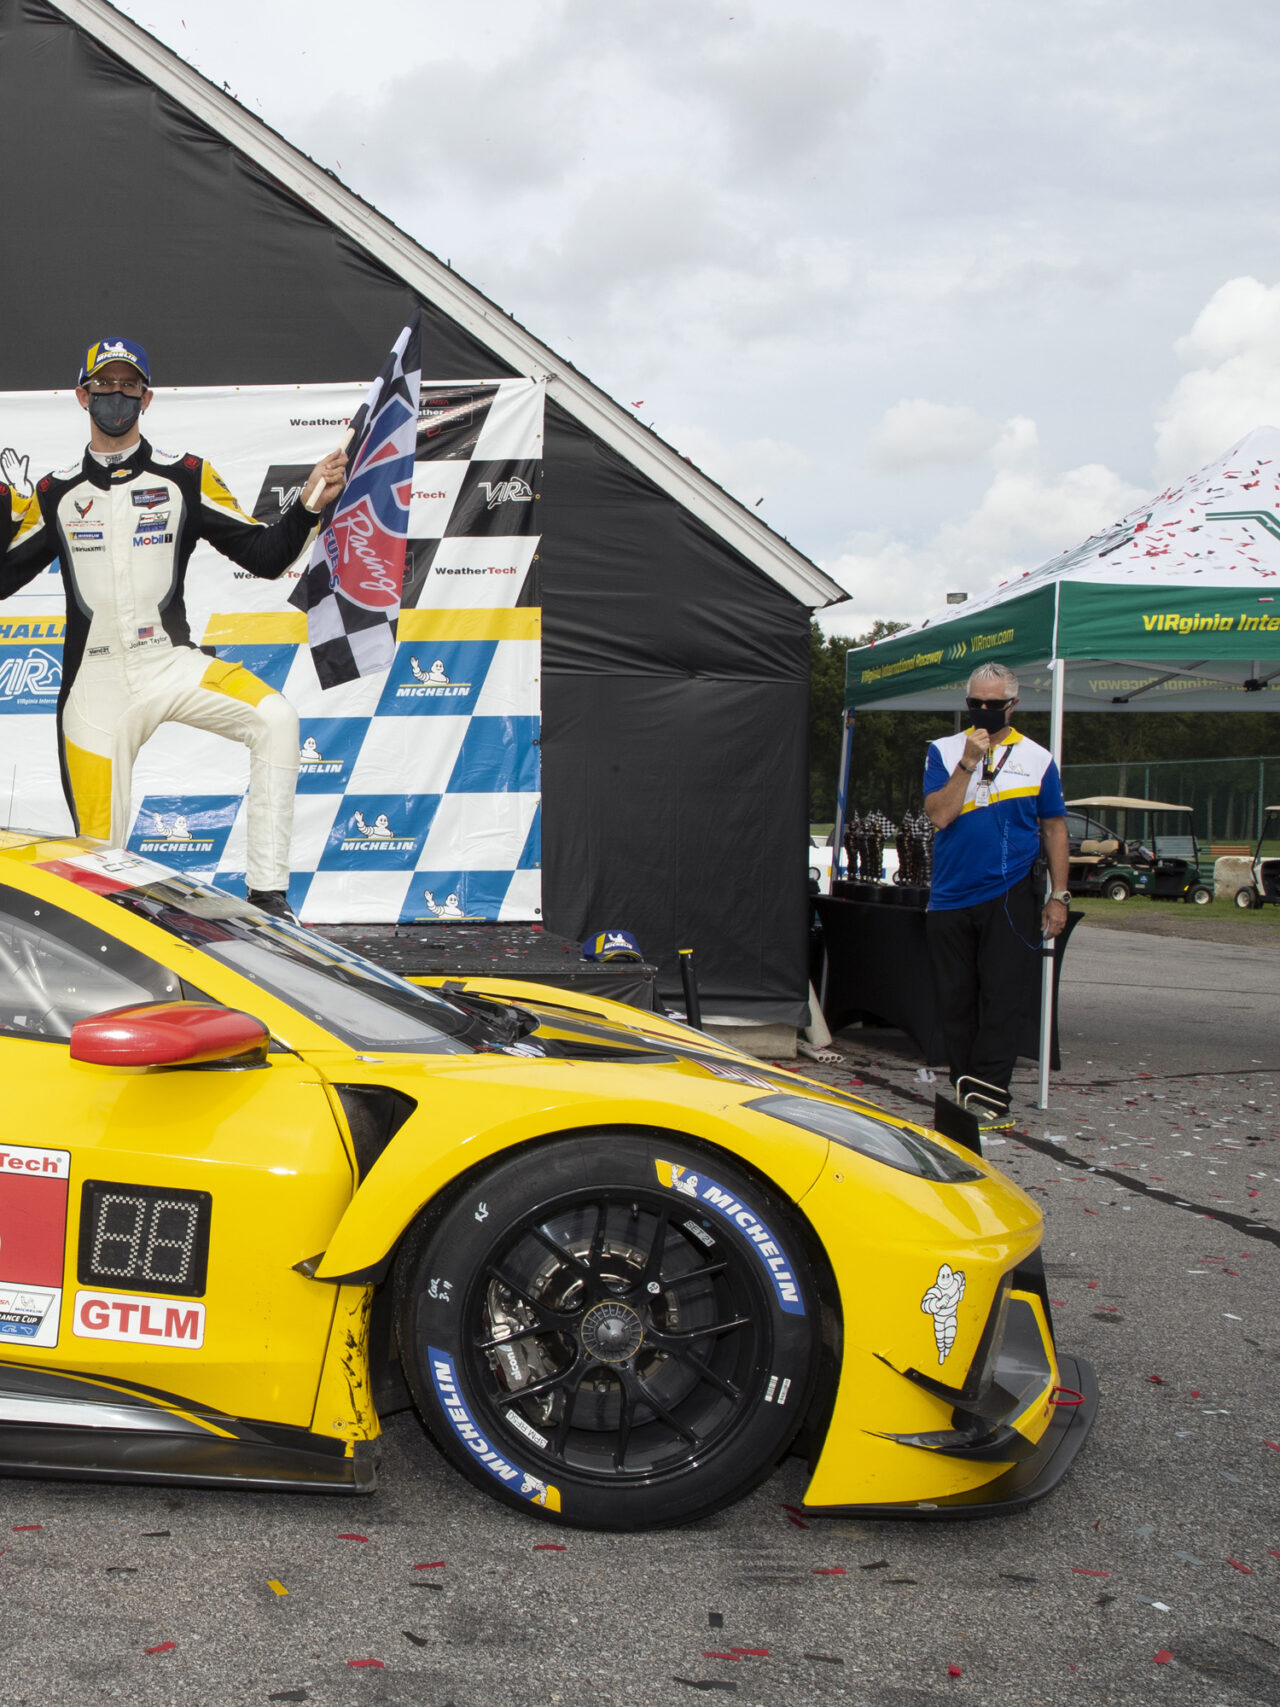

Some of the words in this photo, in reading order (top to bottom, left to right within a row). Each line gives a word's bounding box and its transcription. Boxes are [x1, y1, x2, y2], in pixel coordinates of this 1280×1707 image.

[478, 478, 532, 508] VIR
[436, 567, 516, 575] WeatherTech
[1142, 613, 1234, 634] VIRginia
[971, 629, 1015, 652] VIRnow.com
[396, 688, 470, 697] MICHELIN
[140, 842, 212, 851] MICHELIN
[341, 841, 414, 850] MICHELIN
[703, 1186, 799, 1303] MICHELIN
[80, 1299, 200, 1340] GTLM
[434, 1361, 519, 1481] MICHELIN
